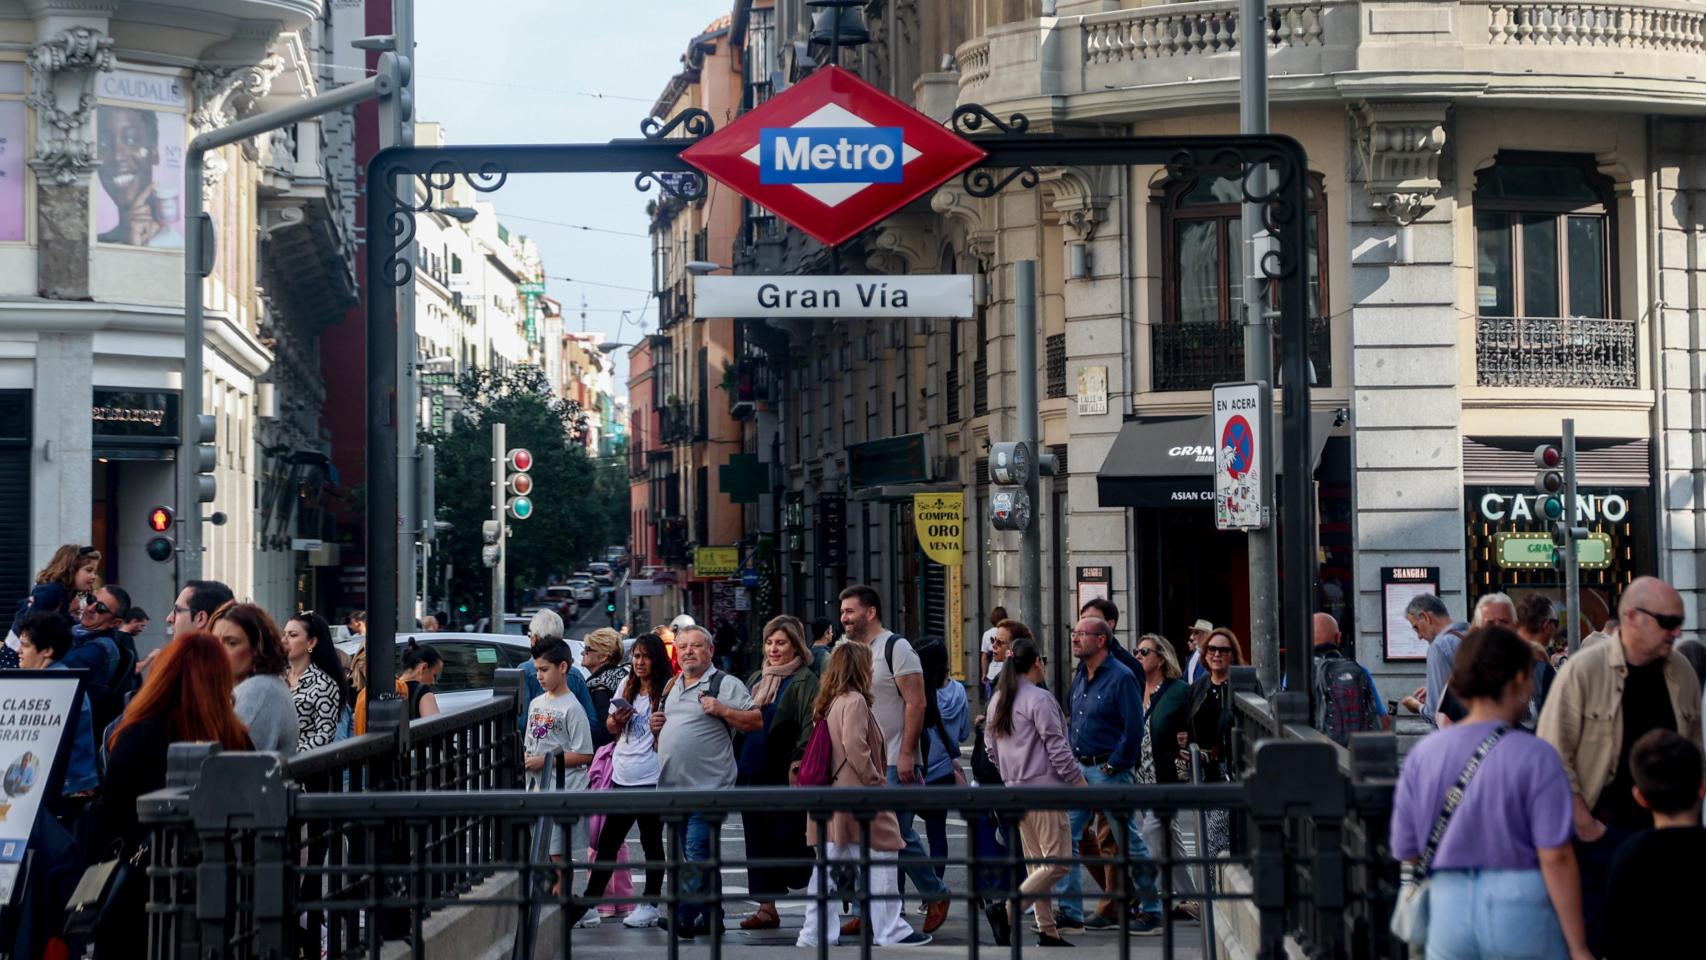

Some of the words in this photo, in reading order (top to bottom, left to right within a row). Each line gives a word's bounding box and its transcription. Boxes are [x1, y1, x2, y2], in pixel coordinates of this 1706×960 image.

[774, 136, 894, 171] Metro
[757, 283, 840, 309] Gran
[856, 283, 909, 309] Vía
[1217, 400, 1228, 411] EN
[1232, 398, 1256, 410] ACERA
[1171, 491, 1198, 501] ASIAN
[1481, 493, 1626, 522] CAINO
[919, 511, 960, 521] COMPRA
[928, 524, 960, 537] ORO
[929, 541, 960, 551] VENTA
[1393, 568, 1428, 579] SHANGHAI
[3, 698, 52, 711] CLASES
[0, 714, 16, 726] LA
[19, 713, 62, 727] BIBLIA
